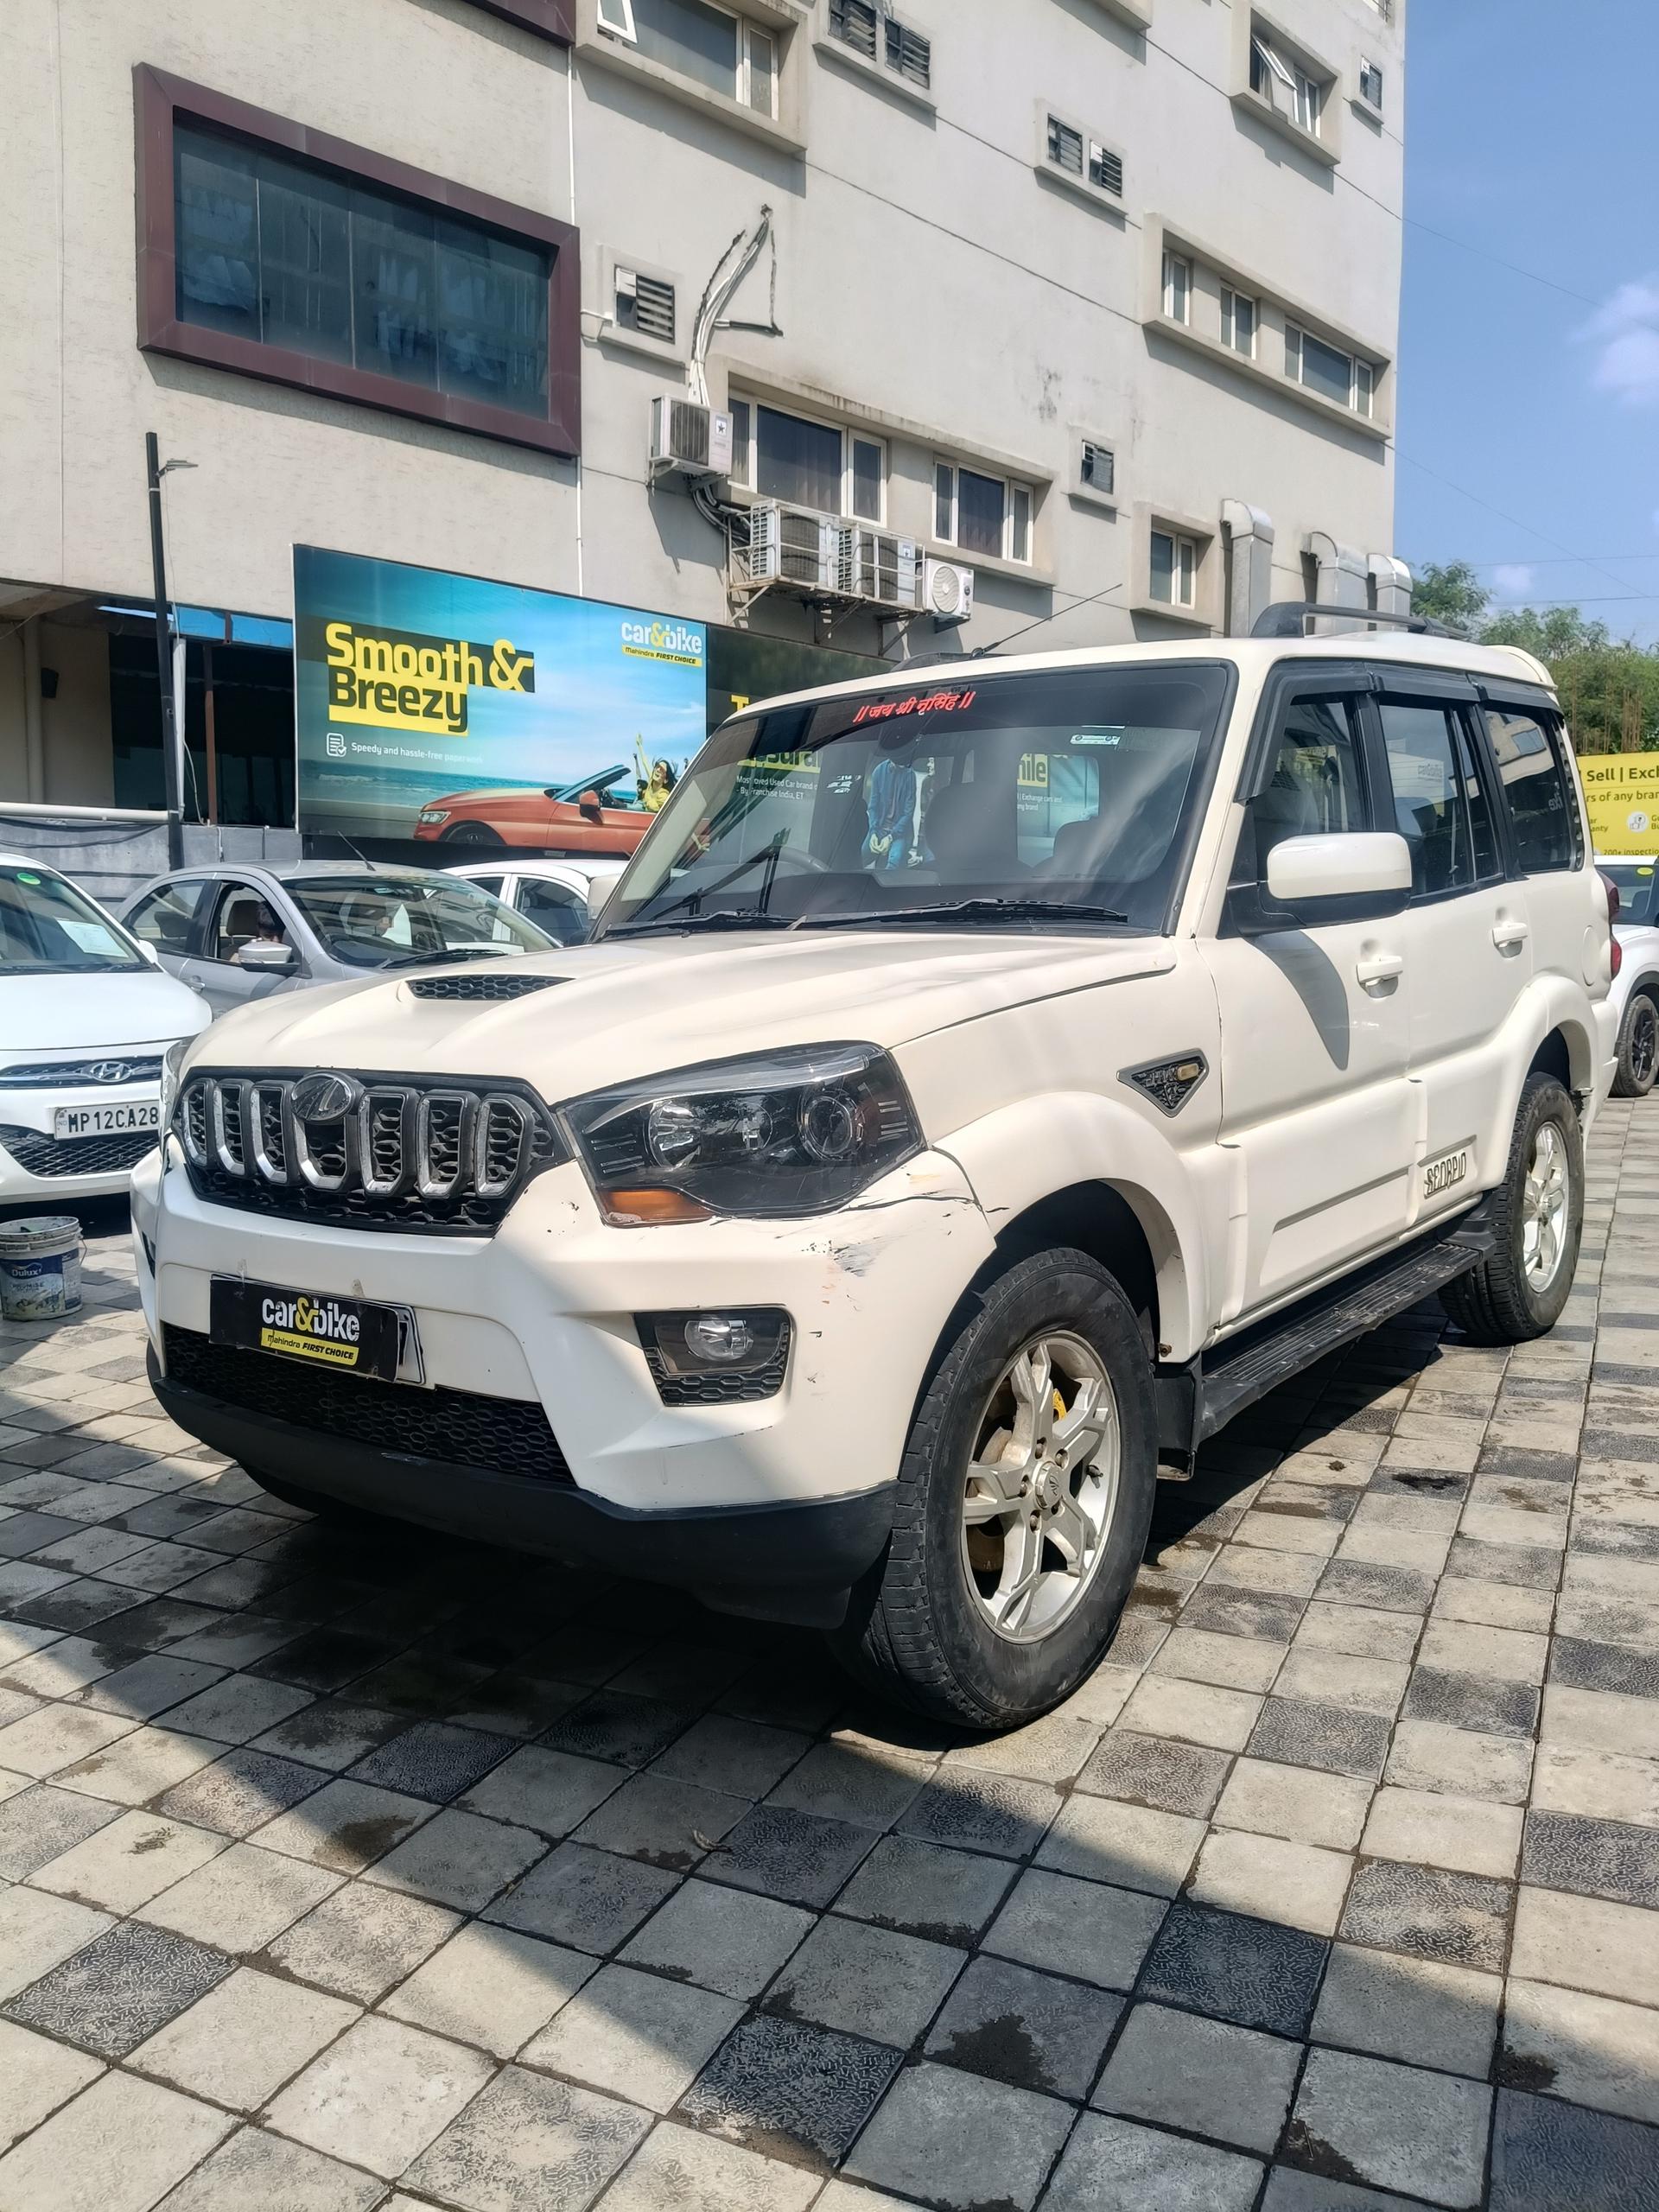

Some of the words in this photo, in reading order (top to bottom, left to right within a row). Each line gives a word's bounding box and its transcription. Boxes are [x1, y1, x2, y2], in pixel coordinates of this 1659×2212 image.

[621, 621, 702, 654] car&bike
[326, 622, 483, 686] Smooth
[489, 639, 534, 691] &
[674, 655, 696, 664] CHOICE
[328, 665, 467, 733] Breezy
[351, 741, 382, 755] Speedy
[383, 746, 399, 756] and
[400, 747, 443, 761] hassle-free
[1586, 767, 1615, 782] Sell
[1599, 791, 1611, 802] of
[1613, 792, 1634, 803] any
[262, 1296, 360, 1342] car&bike
[302, 1342, 325, 1354] FIRST
[325, 1347, 354, 1360] CHOICE
